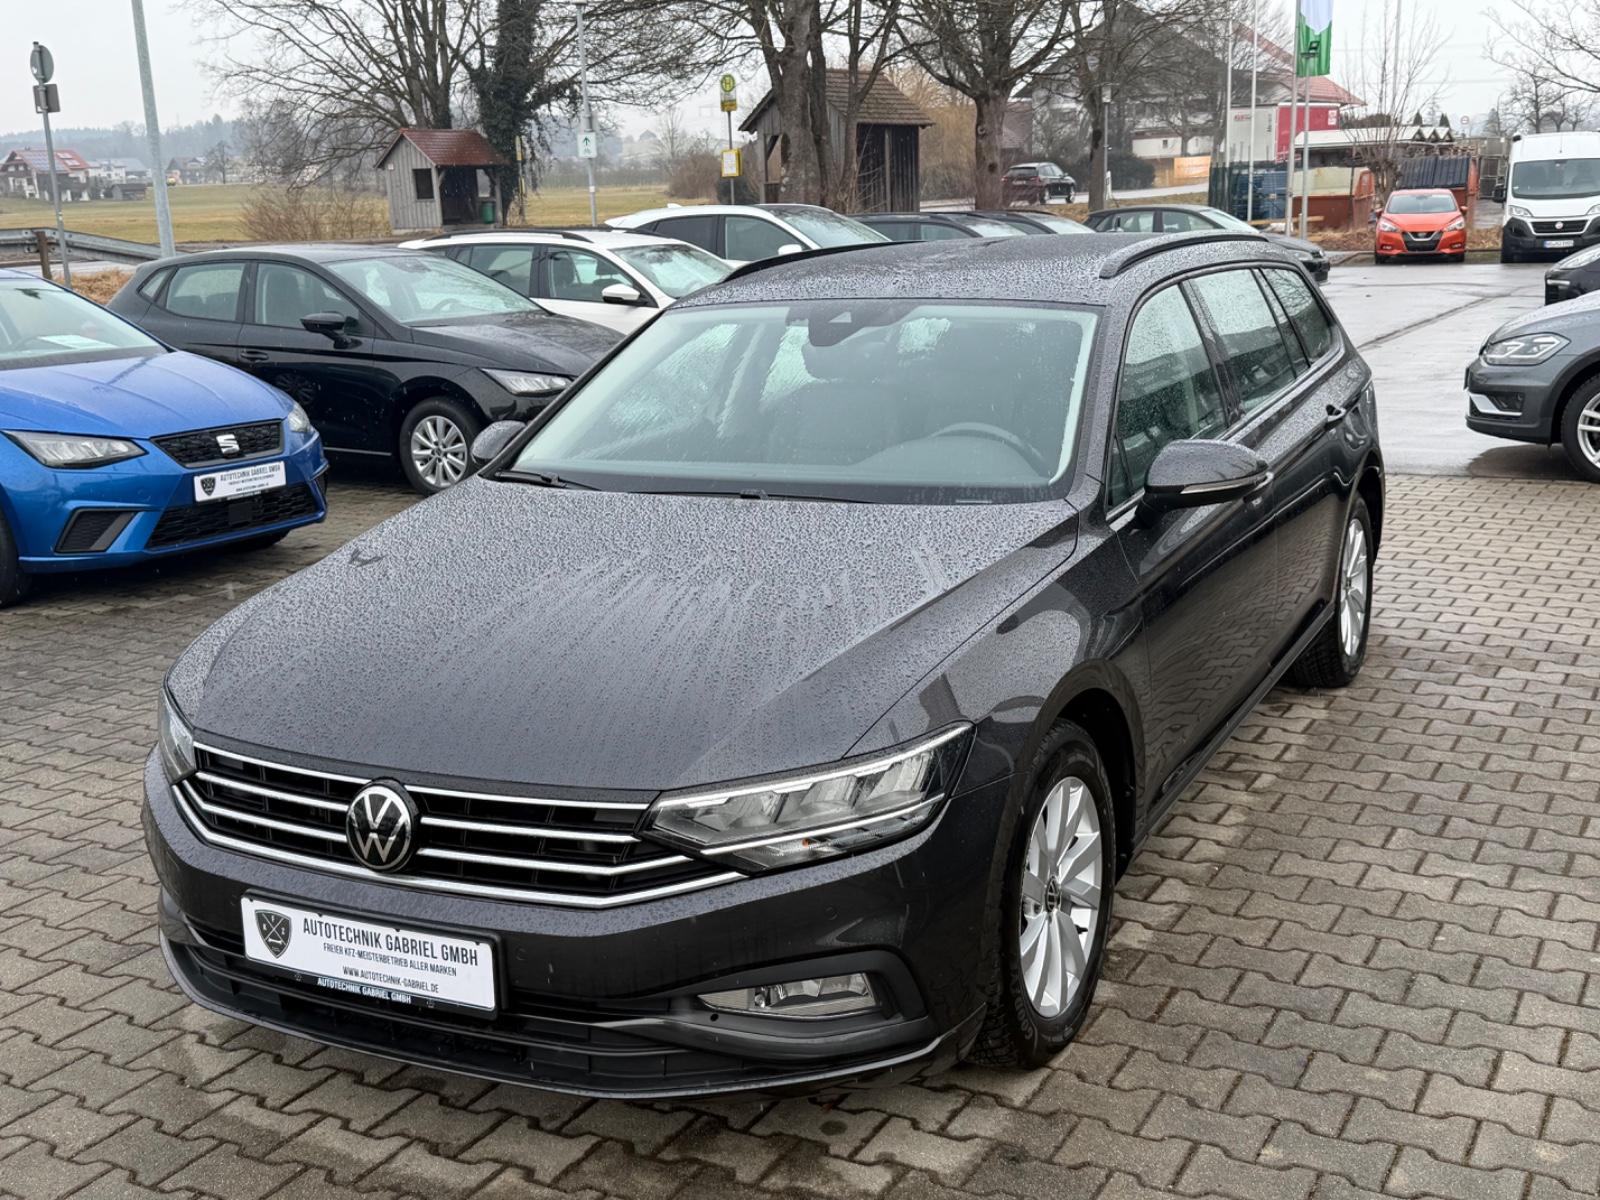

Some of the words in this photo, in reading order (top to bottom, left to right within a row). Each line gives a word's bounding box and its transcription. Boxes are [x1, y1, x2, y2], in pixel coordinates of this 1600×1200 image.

[303, 917, 382, 949] AUTOTECHNIK
[385, 934, 438, 959] GABRIEL
[441, 944, 479, 966] GMBH
[323, 942, 344, 955] FREIER
[344, 947, 408, 968] KFZ-MEISTERBETRIEB
[409, 959, 429, 972] ALLER
[429, 963, 457, 977] MARKEN
[317, 977, 361, 994] AUTOTECHNIK
